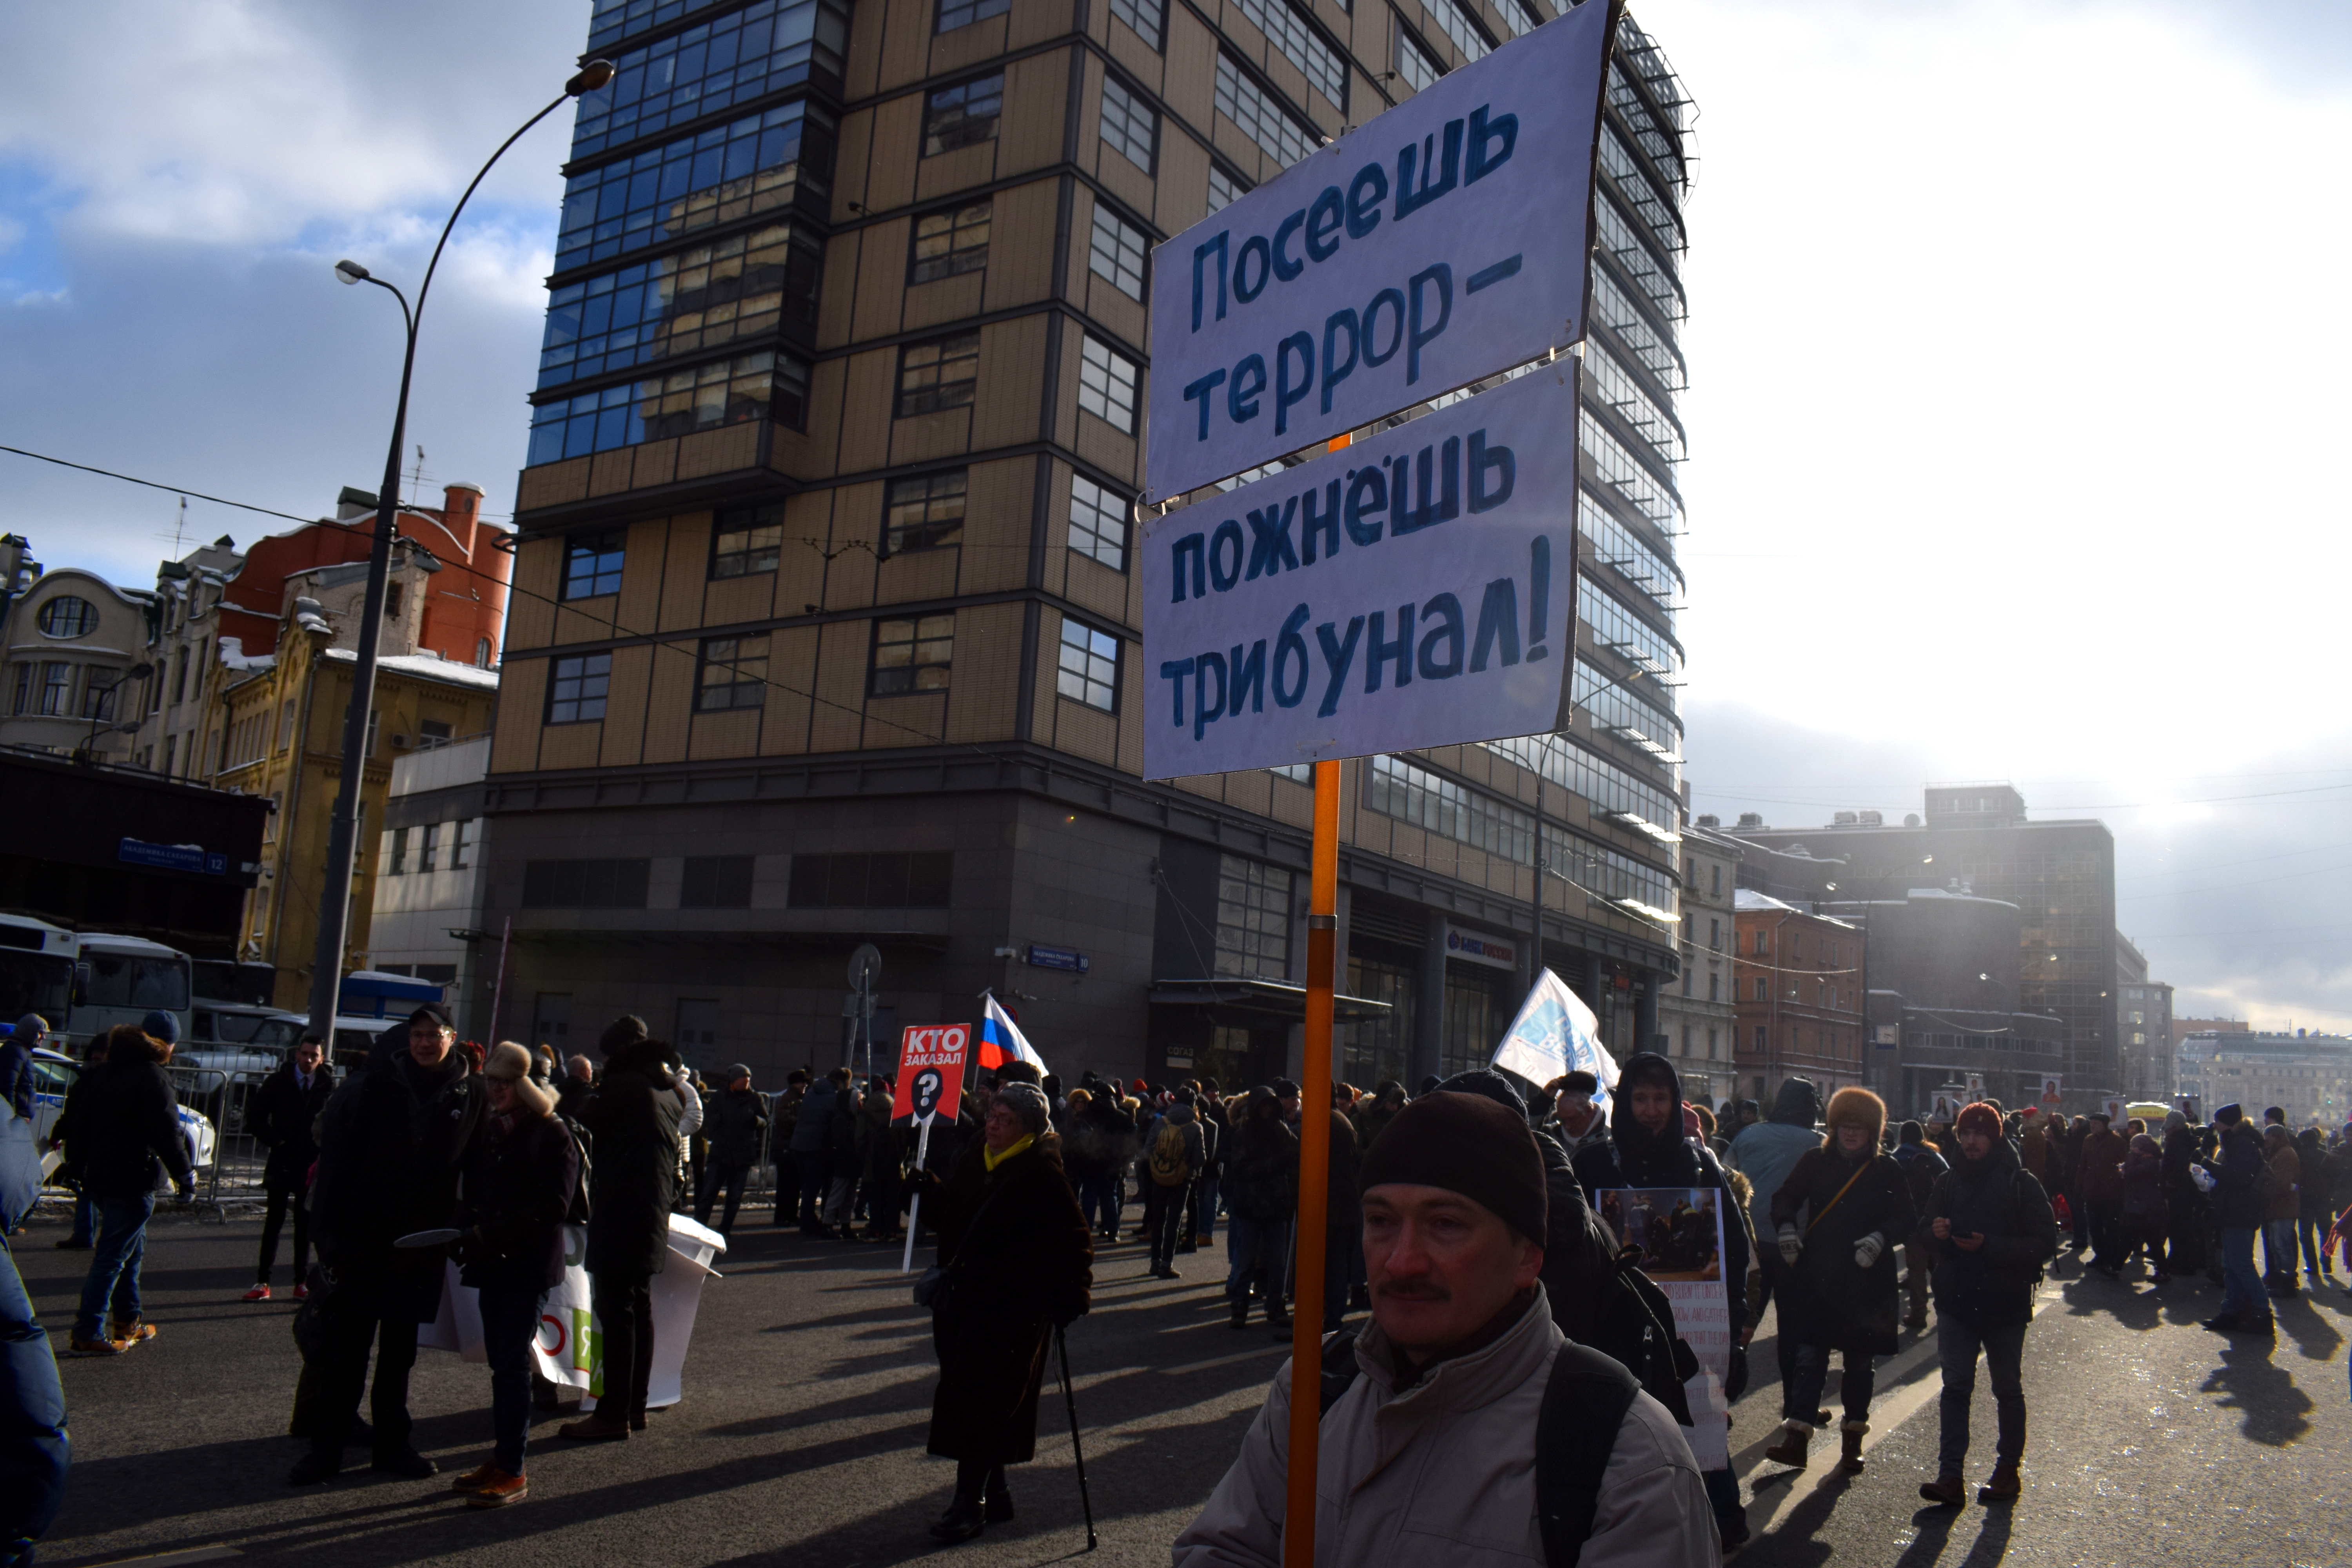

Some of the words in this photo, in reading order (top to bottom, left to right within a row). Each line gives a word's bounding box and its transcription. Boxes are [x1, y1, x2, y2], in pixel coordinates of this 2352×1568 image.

[1192, 103, 1519, 334] Посеешь
[1171, 428, 1516, 603] пожнёшь
[1160, 534, 1550, 741] трибунал!
[124, 846, 165, 857] АКАДЕМИКА
[167, 851, 201, 862] САХАРОВА
[211, 859, 223, 870] 12
[1461, 936, 1483, 955] БАНК
[1081, 958, 1088, 968] 10
[907, 1028, 965, 1053] КТО
[1167, 1046, 1194, 1057] СОГАЗ
[904, 1053, 962, 1067] ЗАКАЗАЛ
[1695, 1284, 1700, 1299] IT
[1702, 1284, 1724, 1299] UNDER
[1708, 1331, 1717, 1345] THE
